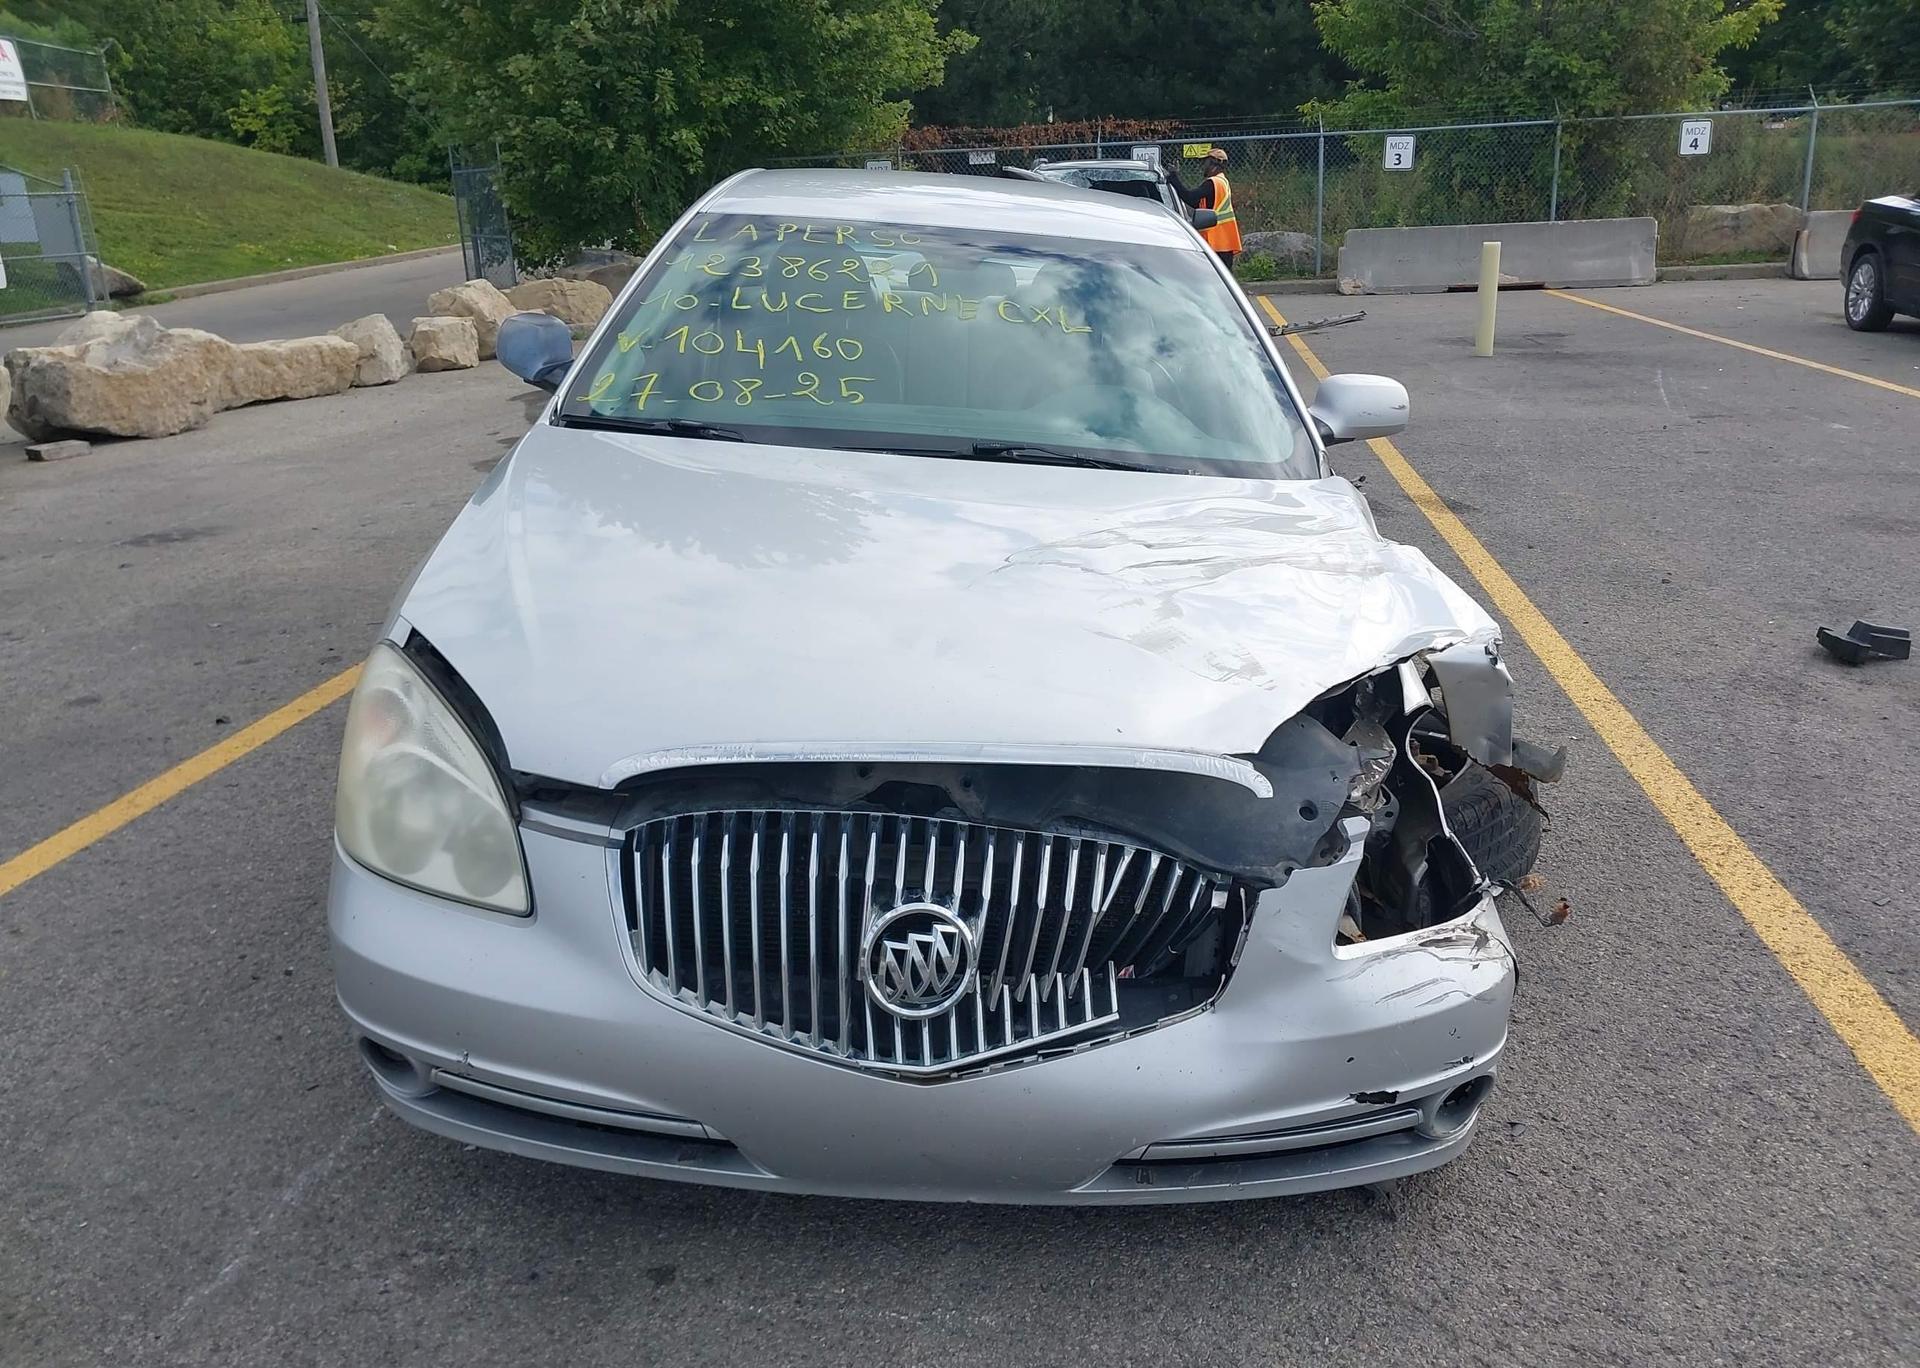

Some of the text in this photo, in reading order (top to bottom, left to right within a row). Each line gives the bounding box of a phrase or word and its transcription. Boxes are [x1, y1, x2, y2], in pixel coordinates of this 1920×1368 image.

[1685, 127, 1707, 136] MDZ
[1390, 141, 1410, 150] MDZ
[1688, 137, 1699, 151] 4
[1393, 153, 1402, 166] 3
[998, 300, 1094, 334] CXL
[575, 372, 877, 411] 27-08-25
